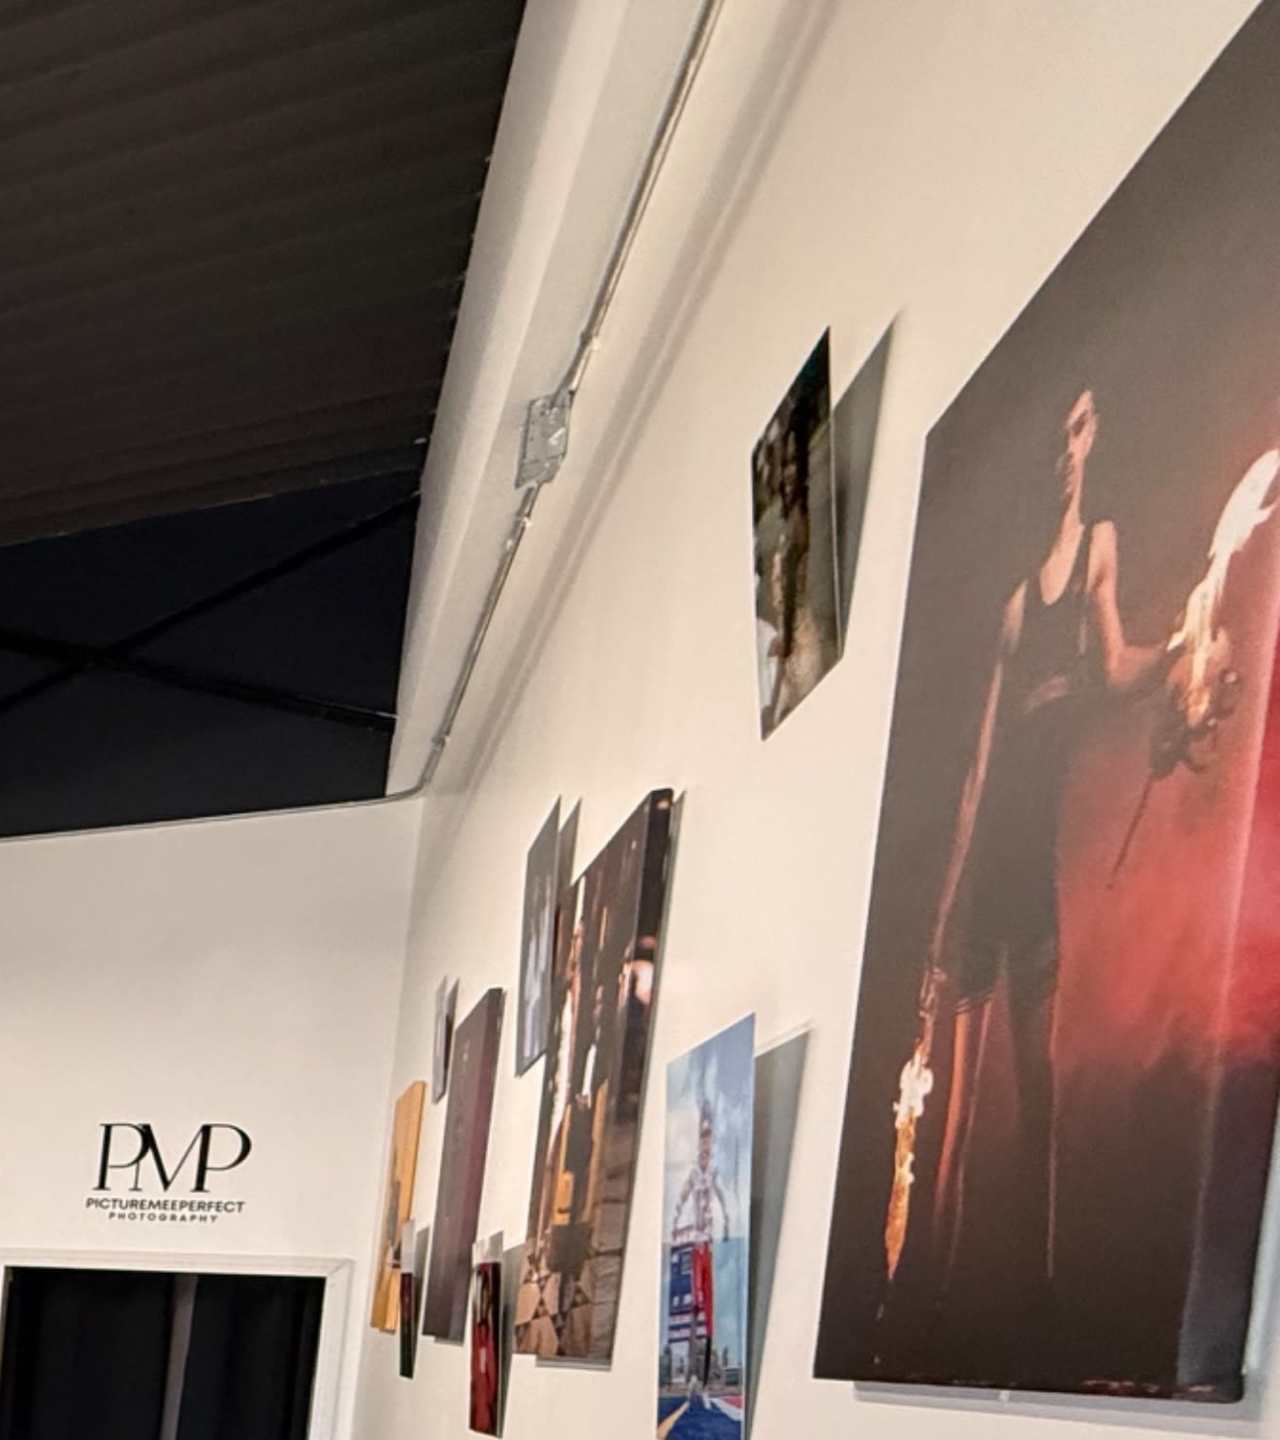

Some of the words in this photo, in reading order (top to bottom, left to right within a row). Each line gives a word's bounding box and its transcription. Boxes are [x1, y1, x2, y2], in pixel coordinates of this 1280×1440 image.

[92, 1123, 252, 1192] PMP
[86, 1198, 245, 1213] PICTUREMEEPERFECT
[109, 1212, 218, 1223] PHOTOGRAPHY
